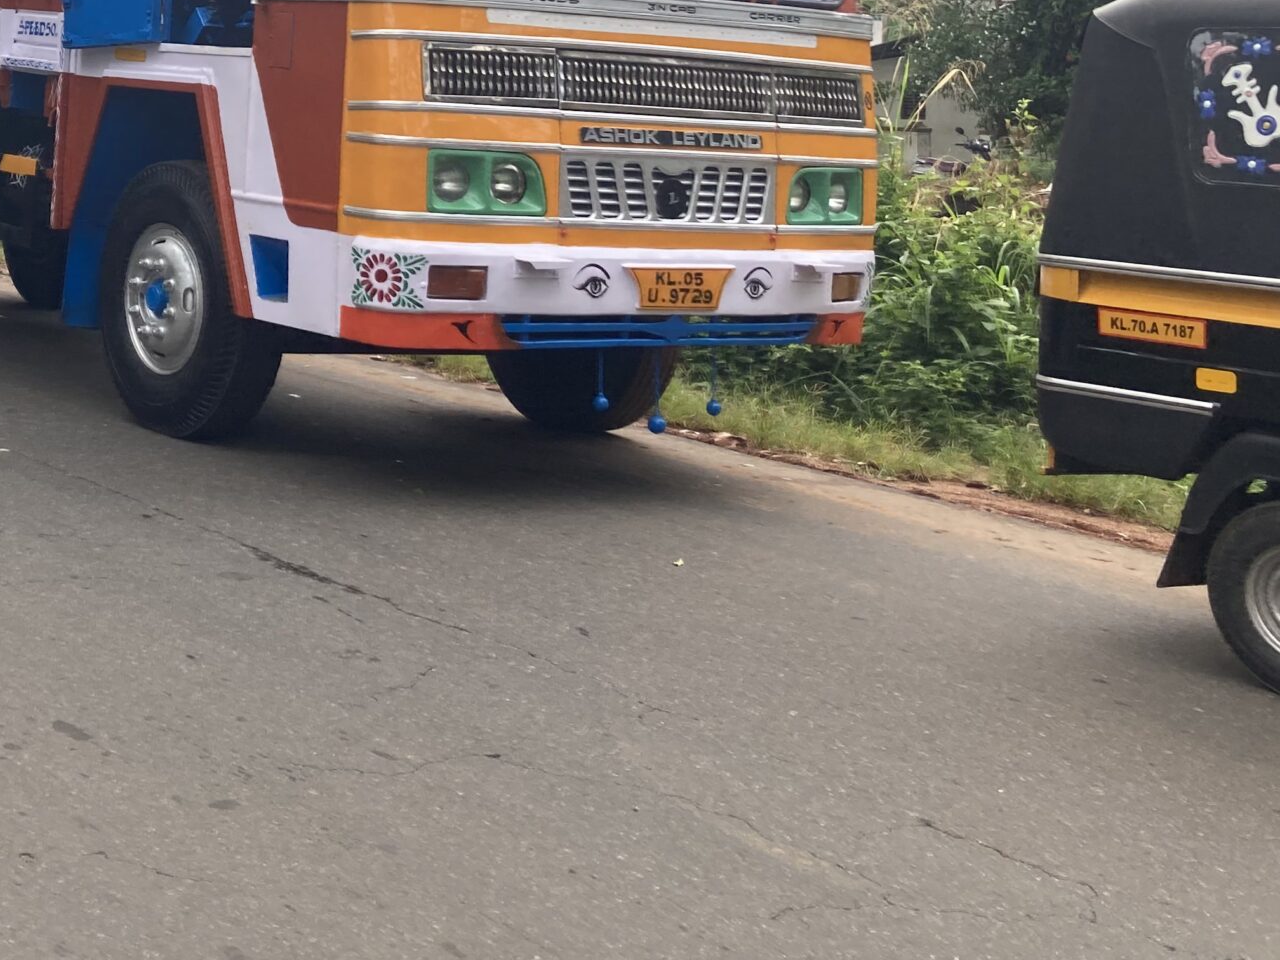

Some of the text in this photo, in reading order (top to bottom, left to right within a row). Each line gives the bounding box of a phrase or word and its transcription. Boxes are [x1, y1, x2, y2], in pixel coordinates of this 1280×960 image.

[750, 12, 801, 24] CARRIER
[584, 127, 762, 150] ASHOK LEYLAND
[656, 271, 704, 286] KL.05
[647, 287, 713, 304] U.9729
[1110, 316, 1195, 339] KL.70.A 7187
